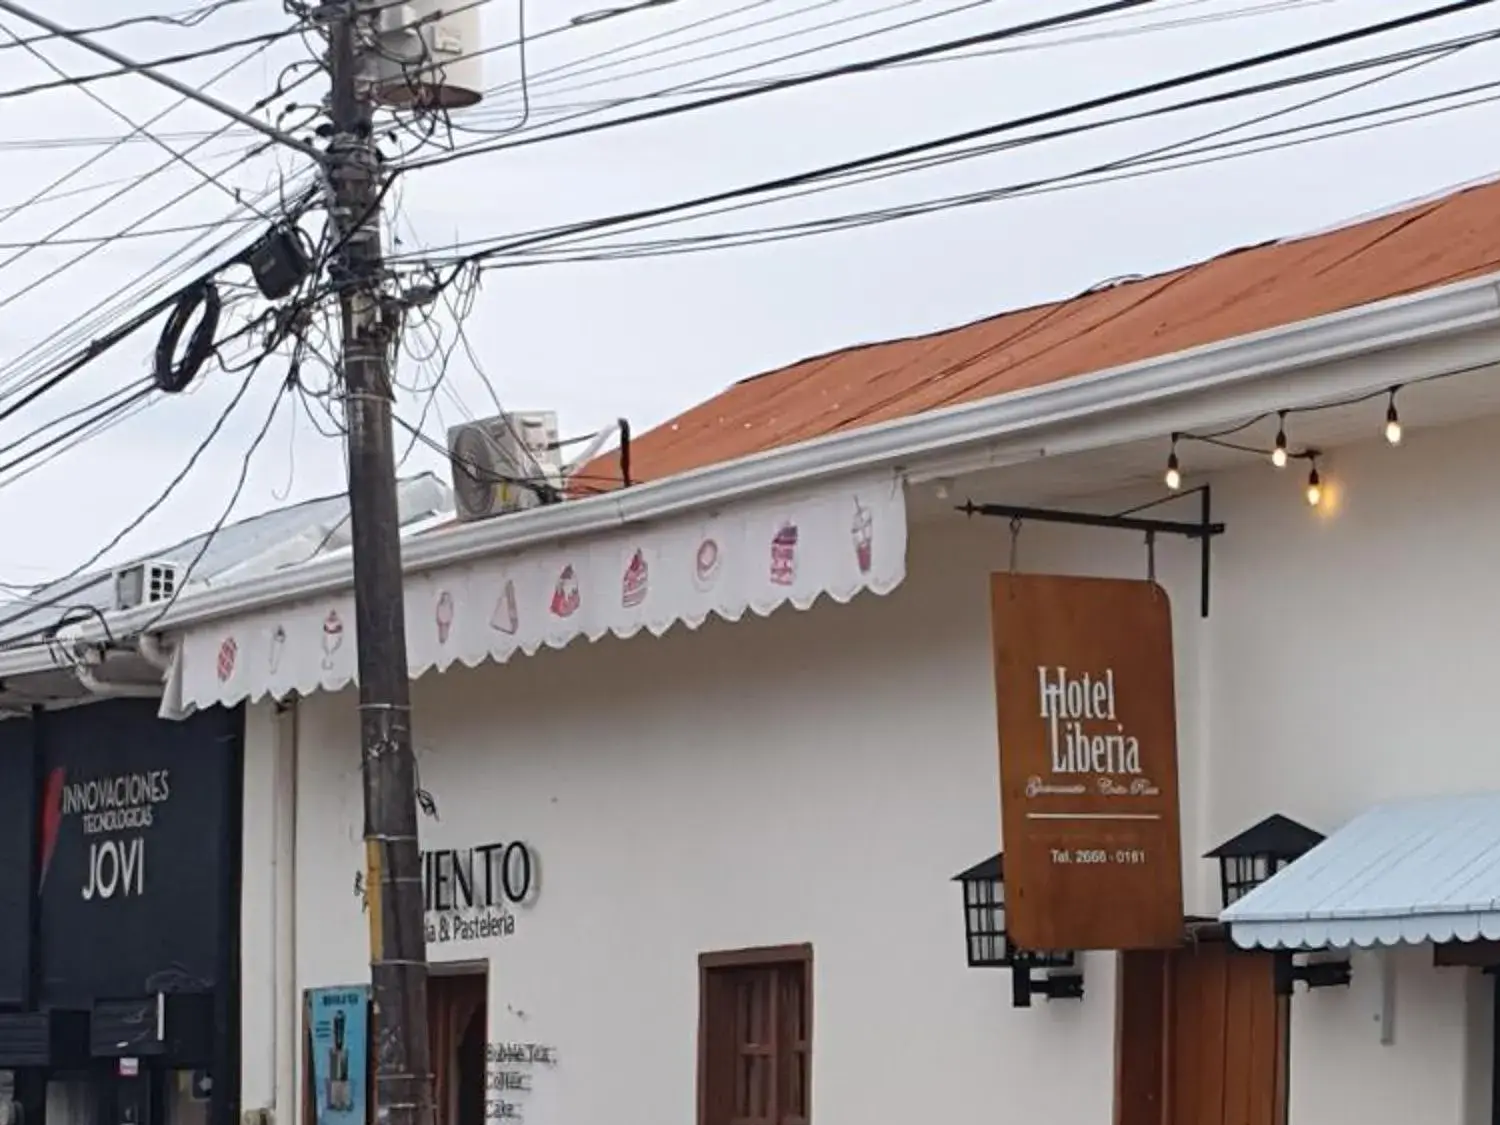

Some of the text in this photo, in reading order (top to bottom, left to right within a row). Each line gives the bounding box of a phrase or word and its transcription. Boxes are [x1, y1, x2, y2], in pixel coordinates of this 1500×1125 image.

[1038, 666, 1116, 720] Hotel
[1052, 684, 1141, 773] Liberia
[63, 769, 168, 814] INNOVACIONES
[82, 837, 144, 900] JOVI
